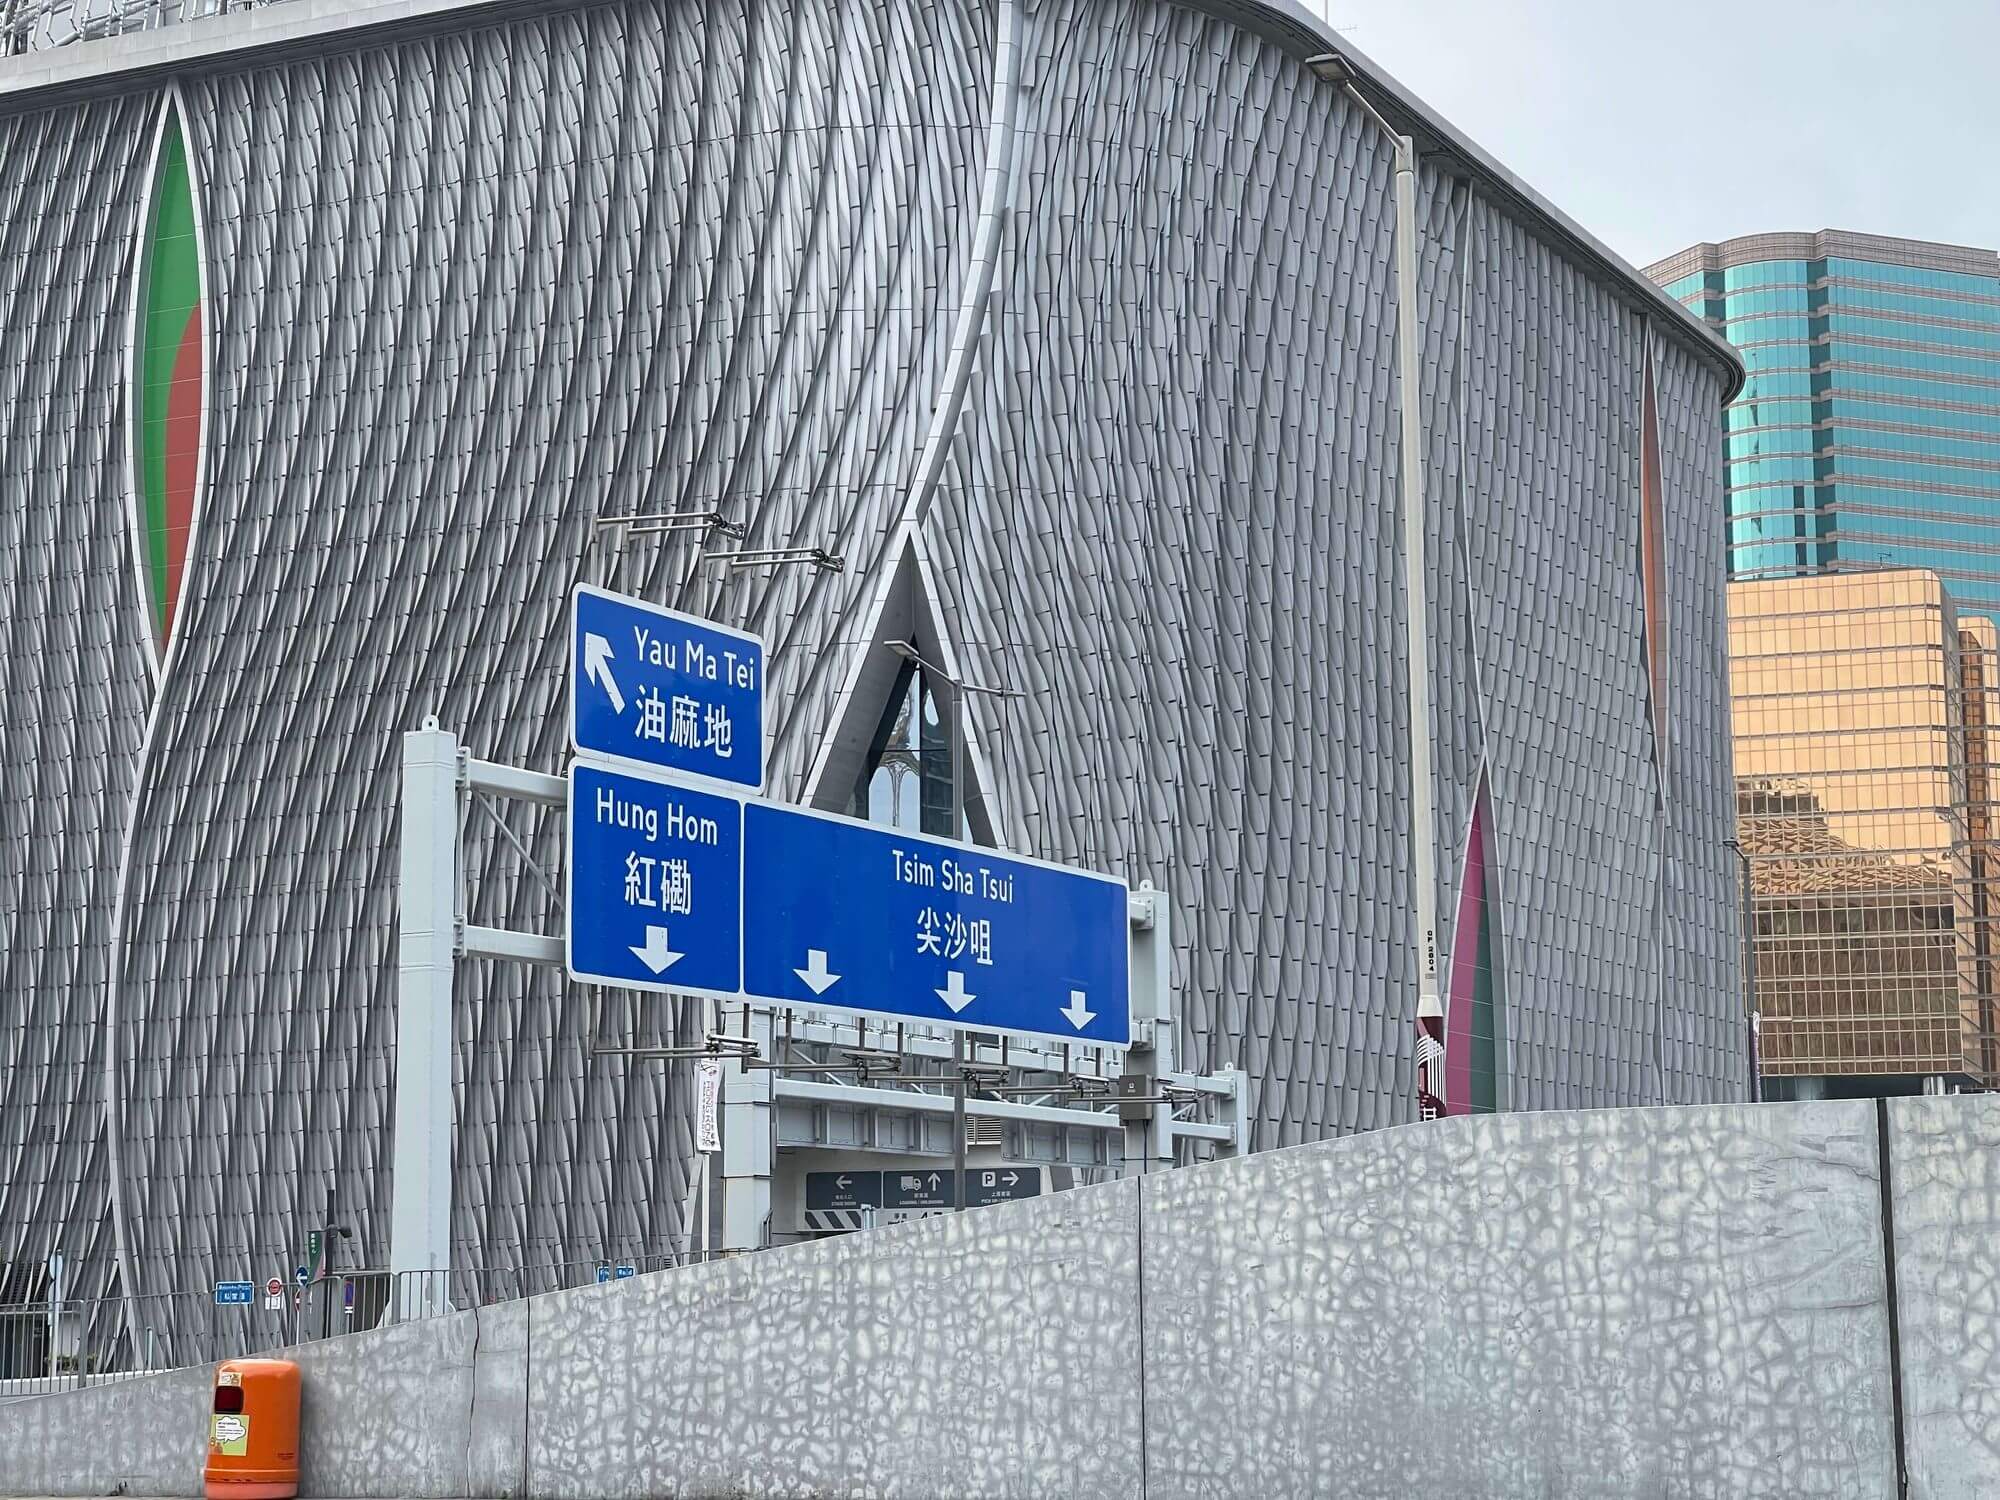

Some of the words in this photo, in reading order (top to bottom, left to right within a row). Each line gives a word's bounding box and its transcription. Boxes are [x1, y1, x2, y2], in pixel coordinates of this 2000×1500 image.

[635, 626, 675, 669] Yau
[686, 640, 716, 680] Ma
[724, 652, 753, 689] Tei
[634, 684, 733, 758] 油麻地
[598, 788, 657, 841] Hung
[668, 803, 716, 845] Hom
[625, 851, 690, 914] 紅磡
[893, 850, 933, 886] Tsim
[942, 860, 973, 894] Sha
[980, 869, 1012, 903] Tsui
[917, 907, 992, 965] 尖沙咀
